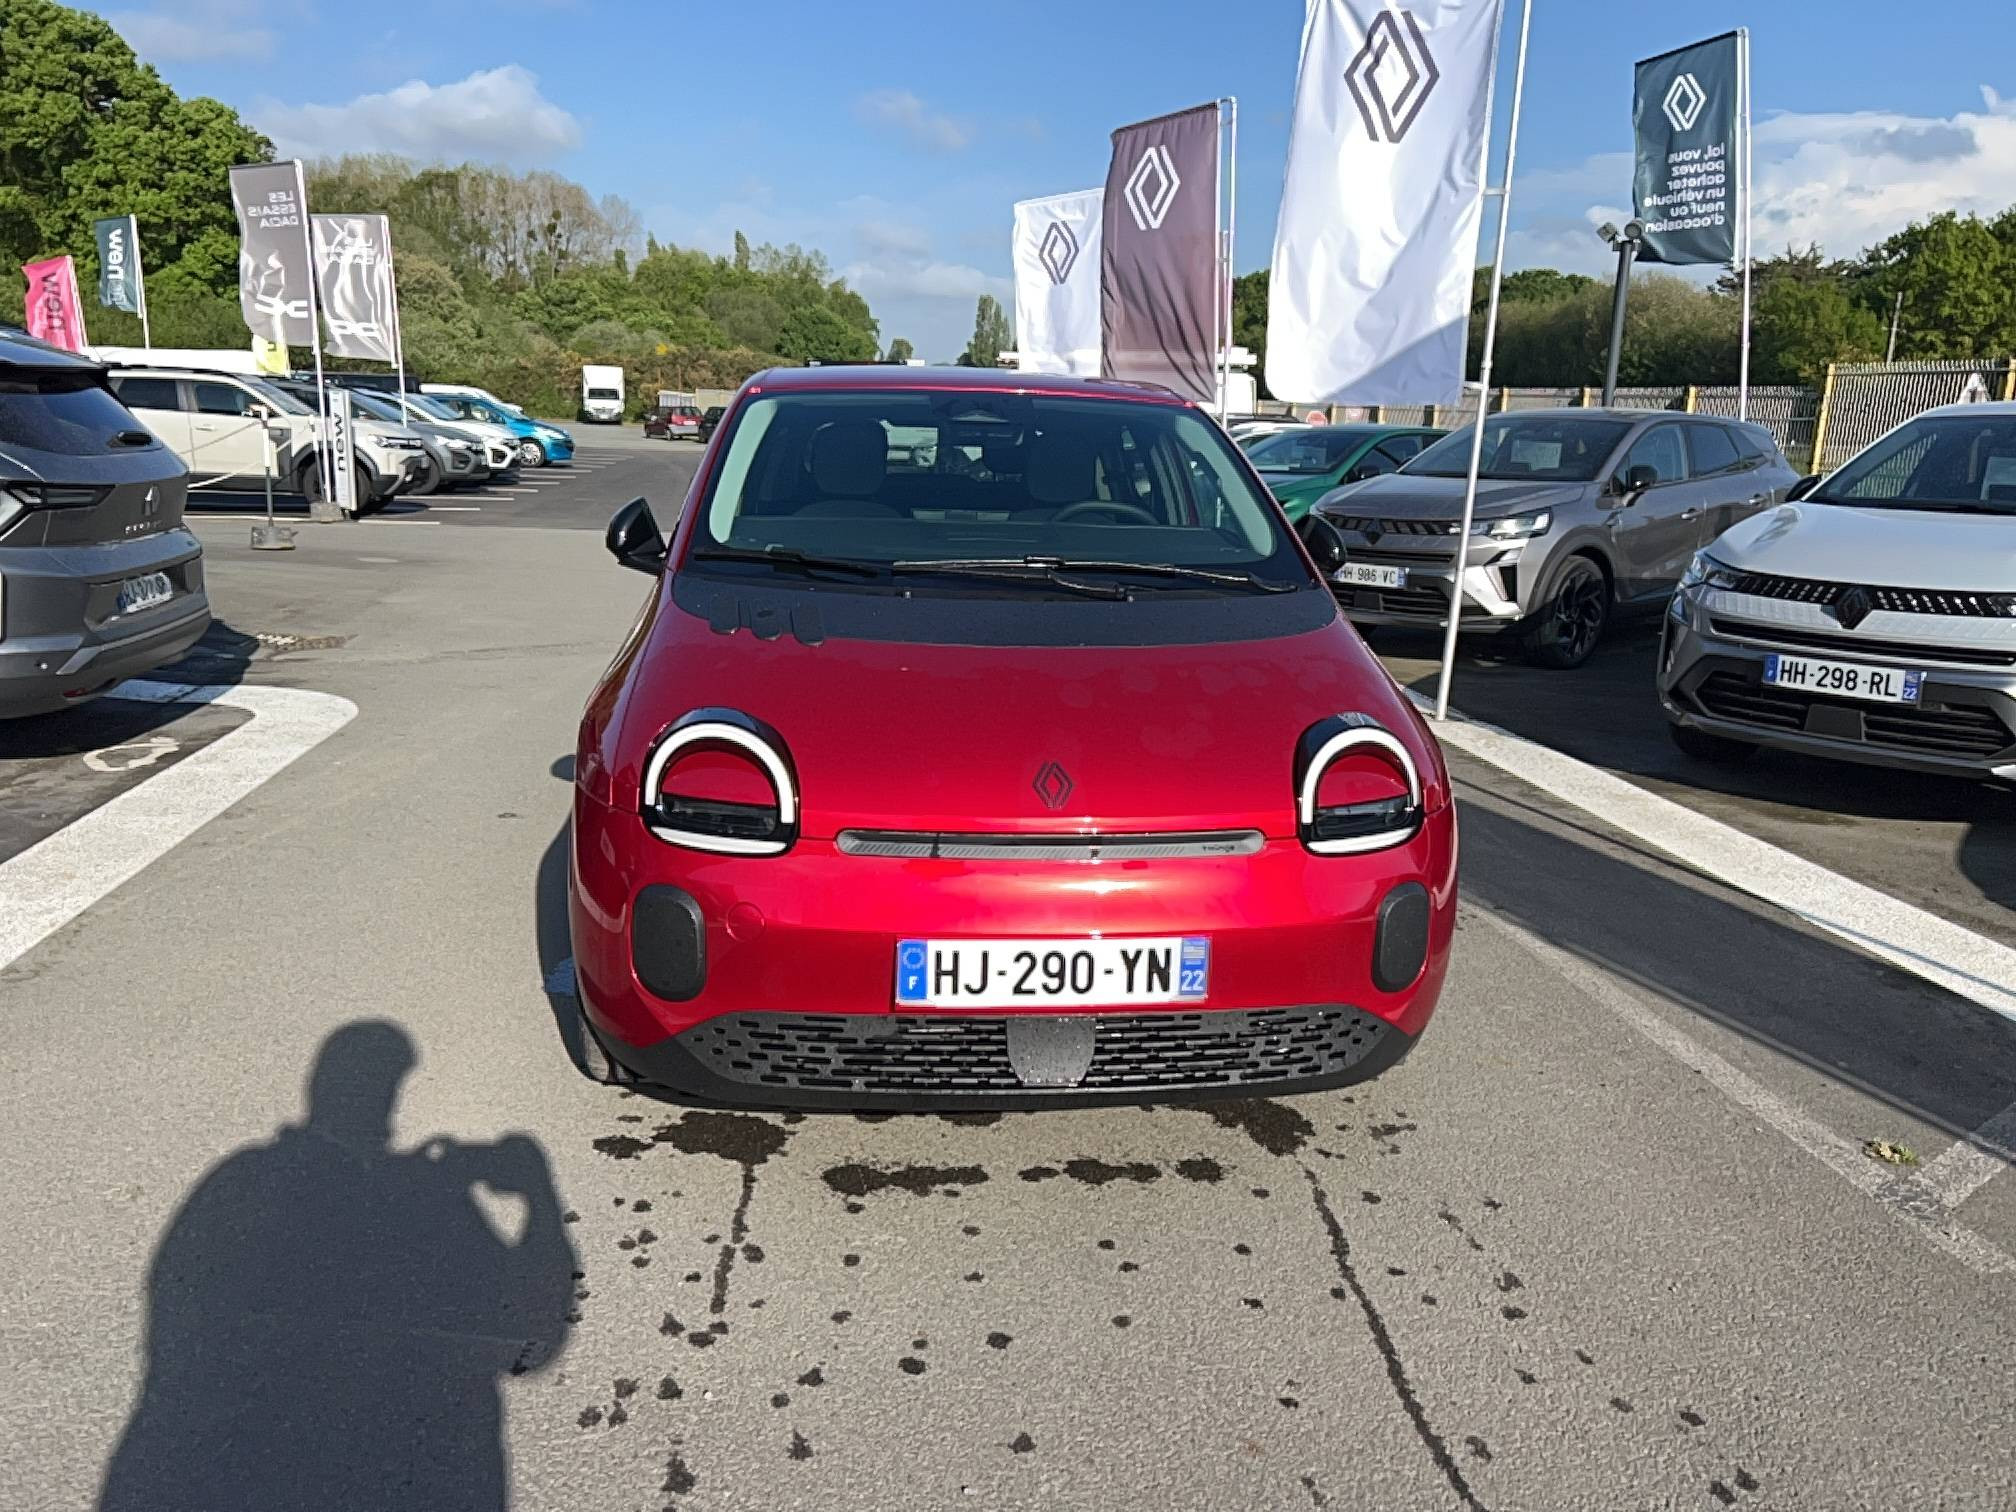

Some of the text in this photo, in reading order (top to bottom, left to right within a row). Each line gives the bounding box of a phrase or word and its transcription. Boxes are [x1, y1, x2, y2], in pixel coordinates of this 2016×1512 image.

[1779, 660, 1897, 697] HH-298-RL
[908, 948, 1204, 995] F HJ-290-YN 22
